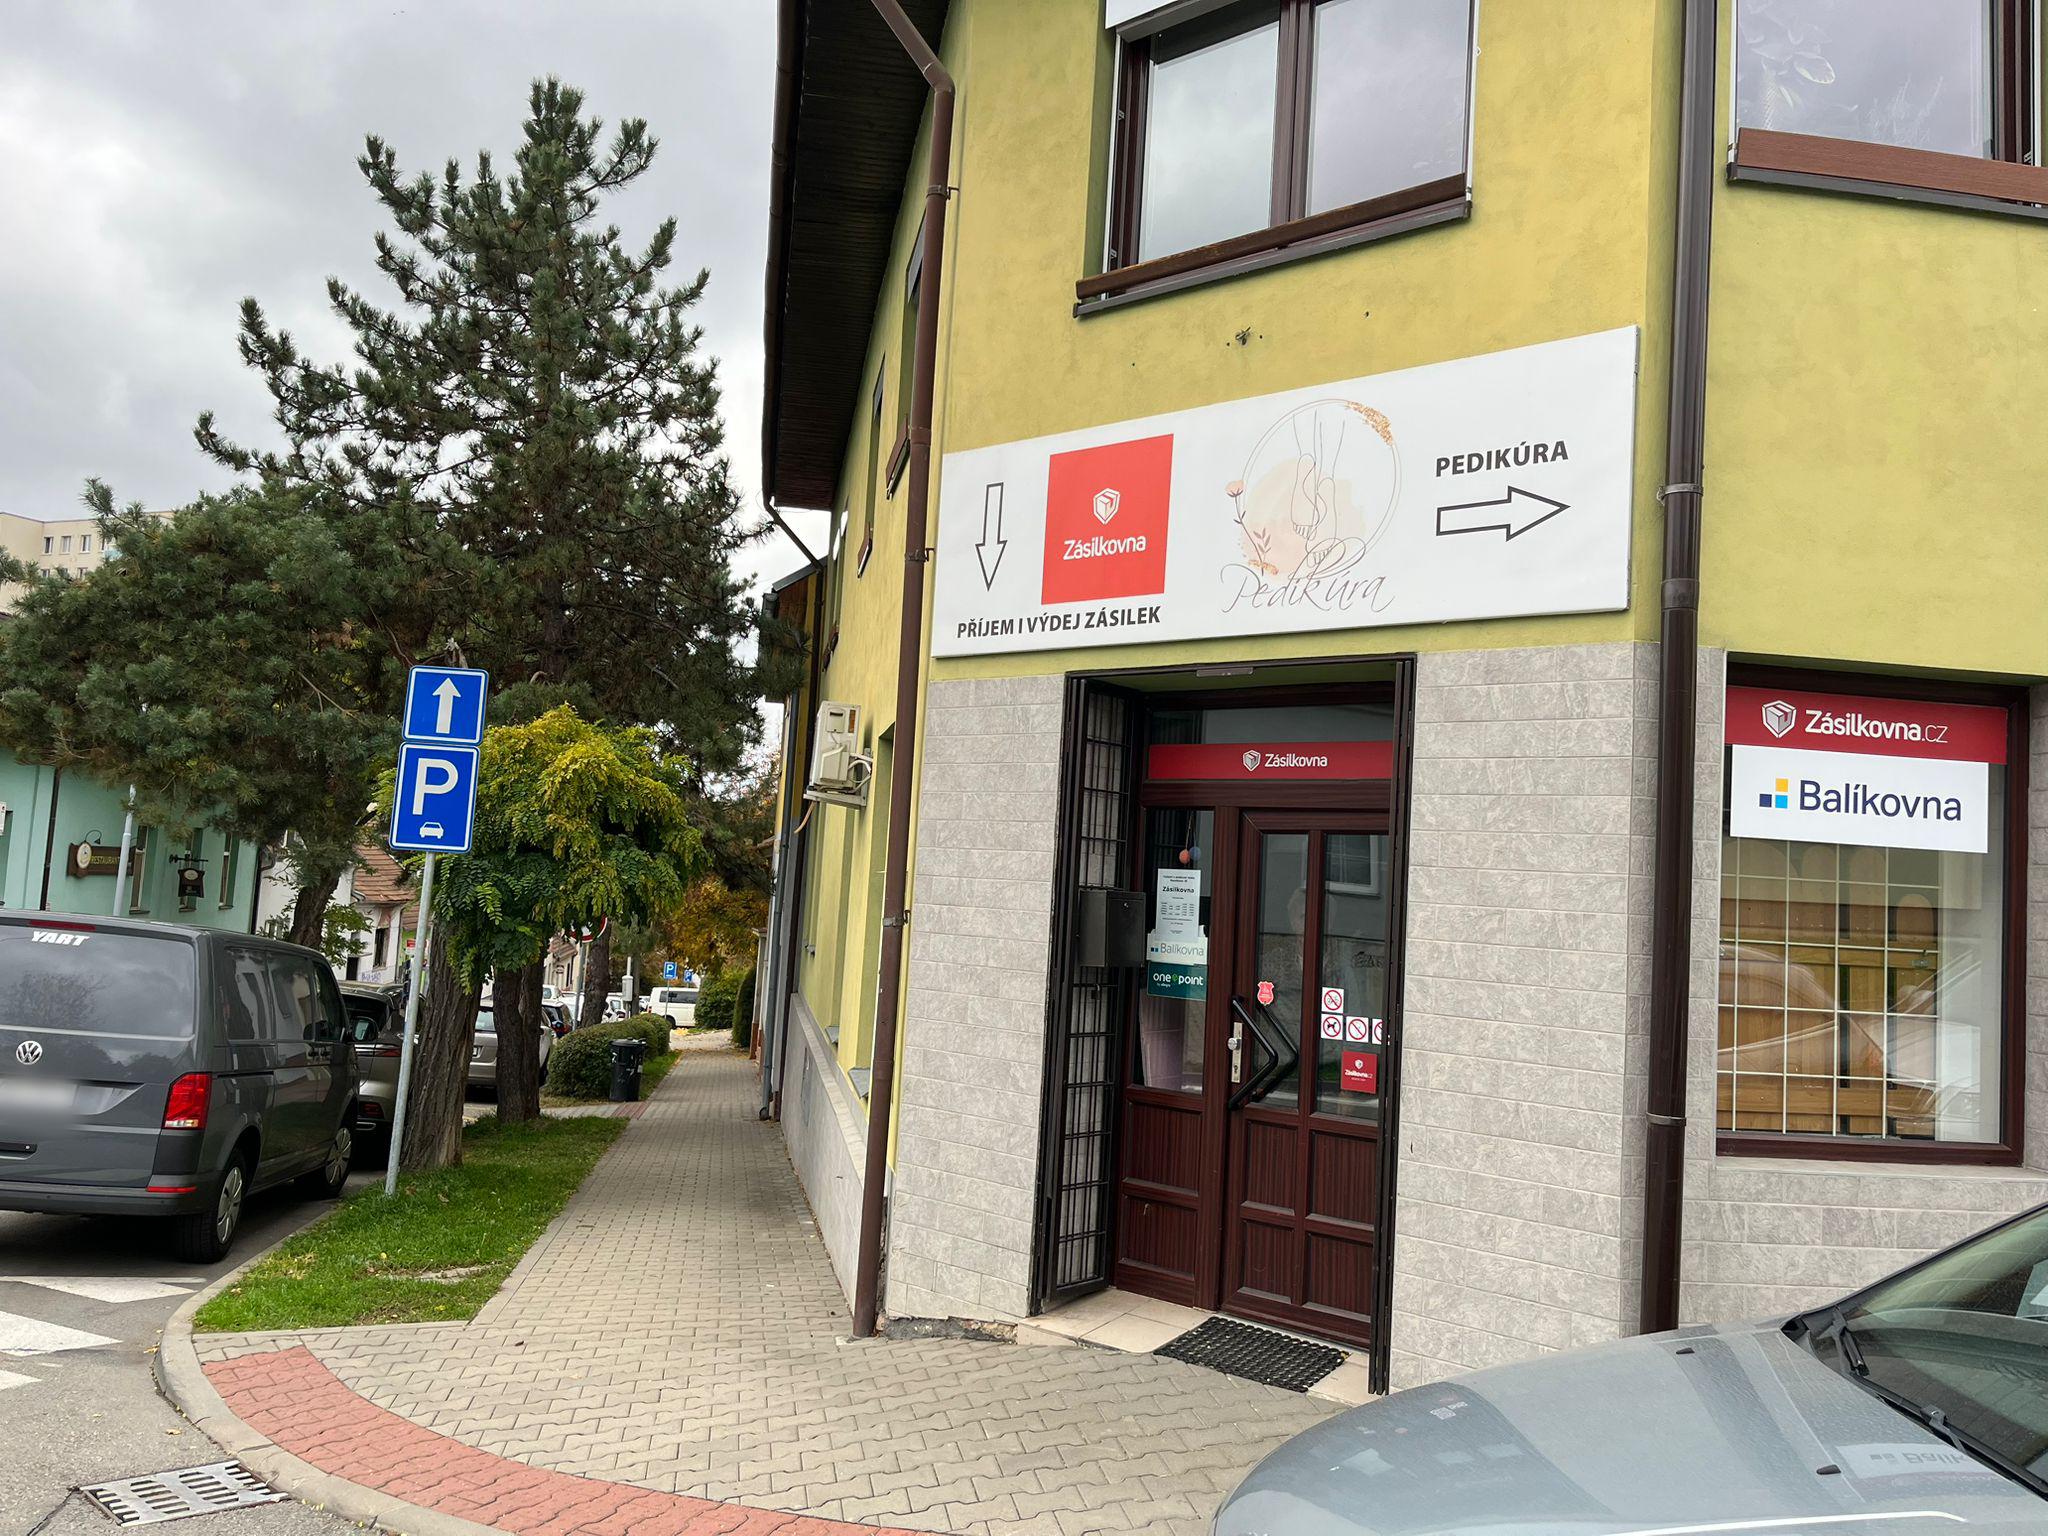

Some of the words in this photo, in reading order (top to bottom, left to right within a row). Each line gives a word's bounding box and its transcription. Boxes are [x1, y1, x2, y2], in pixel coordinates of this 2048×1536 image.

[1435, 440, 1569, 477] PEDIKÚRA
[1062, 535, 1147, 561] Zásilkovna
[1220, 537, 1396, 613] Pedikúra
[957, 618, 1014, 638] PŘÍJEM
[1018, 618, 1023, 634] I
[1026, 612, 1081, 634] VÝDEJ
[1084, 605, 1161, 629] ZÁSILEK
[1264, 753, 1328, 768] Zásilkovna
[412, 757, 459, 816] P
[1800, 779, 1962, 822] Balíkovna
[1162, 886, 1195, 894] Zásilkovna
[1160, 942, 1205, 957] Balíkovna
[666, 964, 675, 974] P
[1152, 972, 1172, 983] one
[1178, 974, 1204, 986] point
